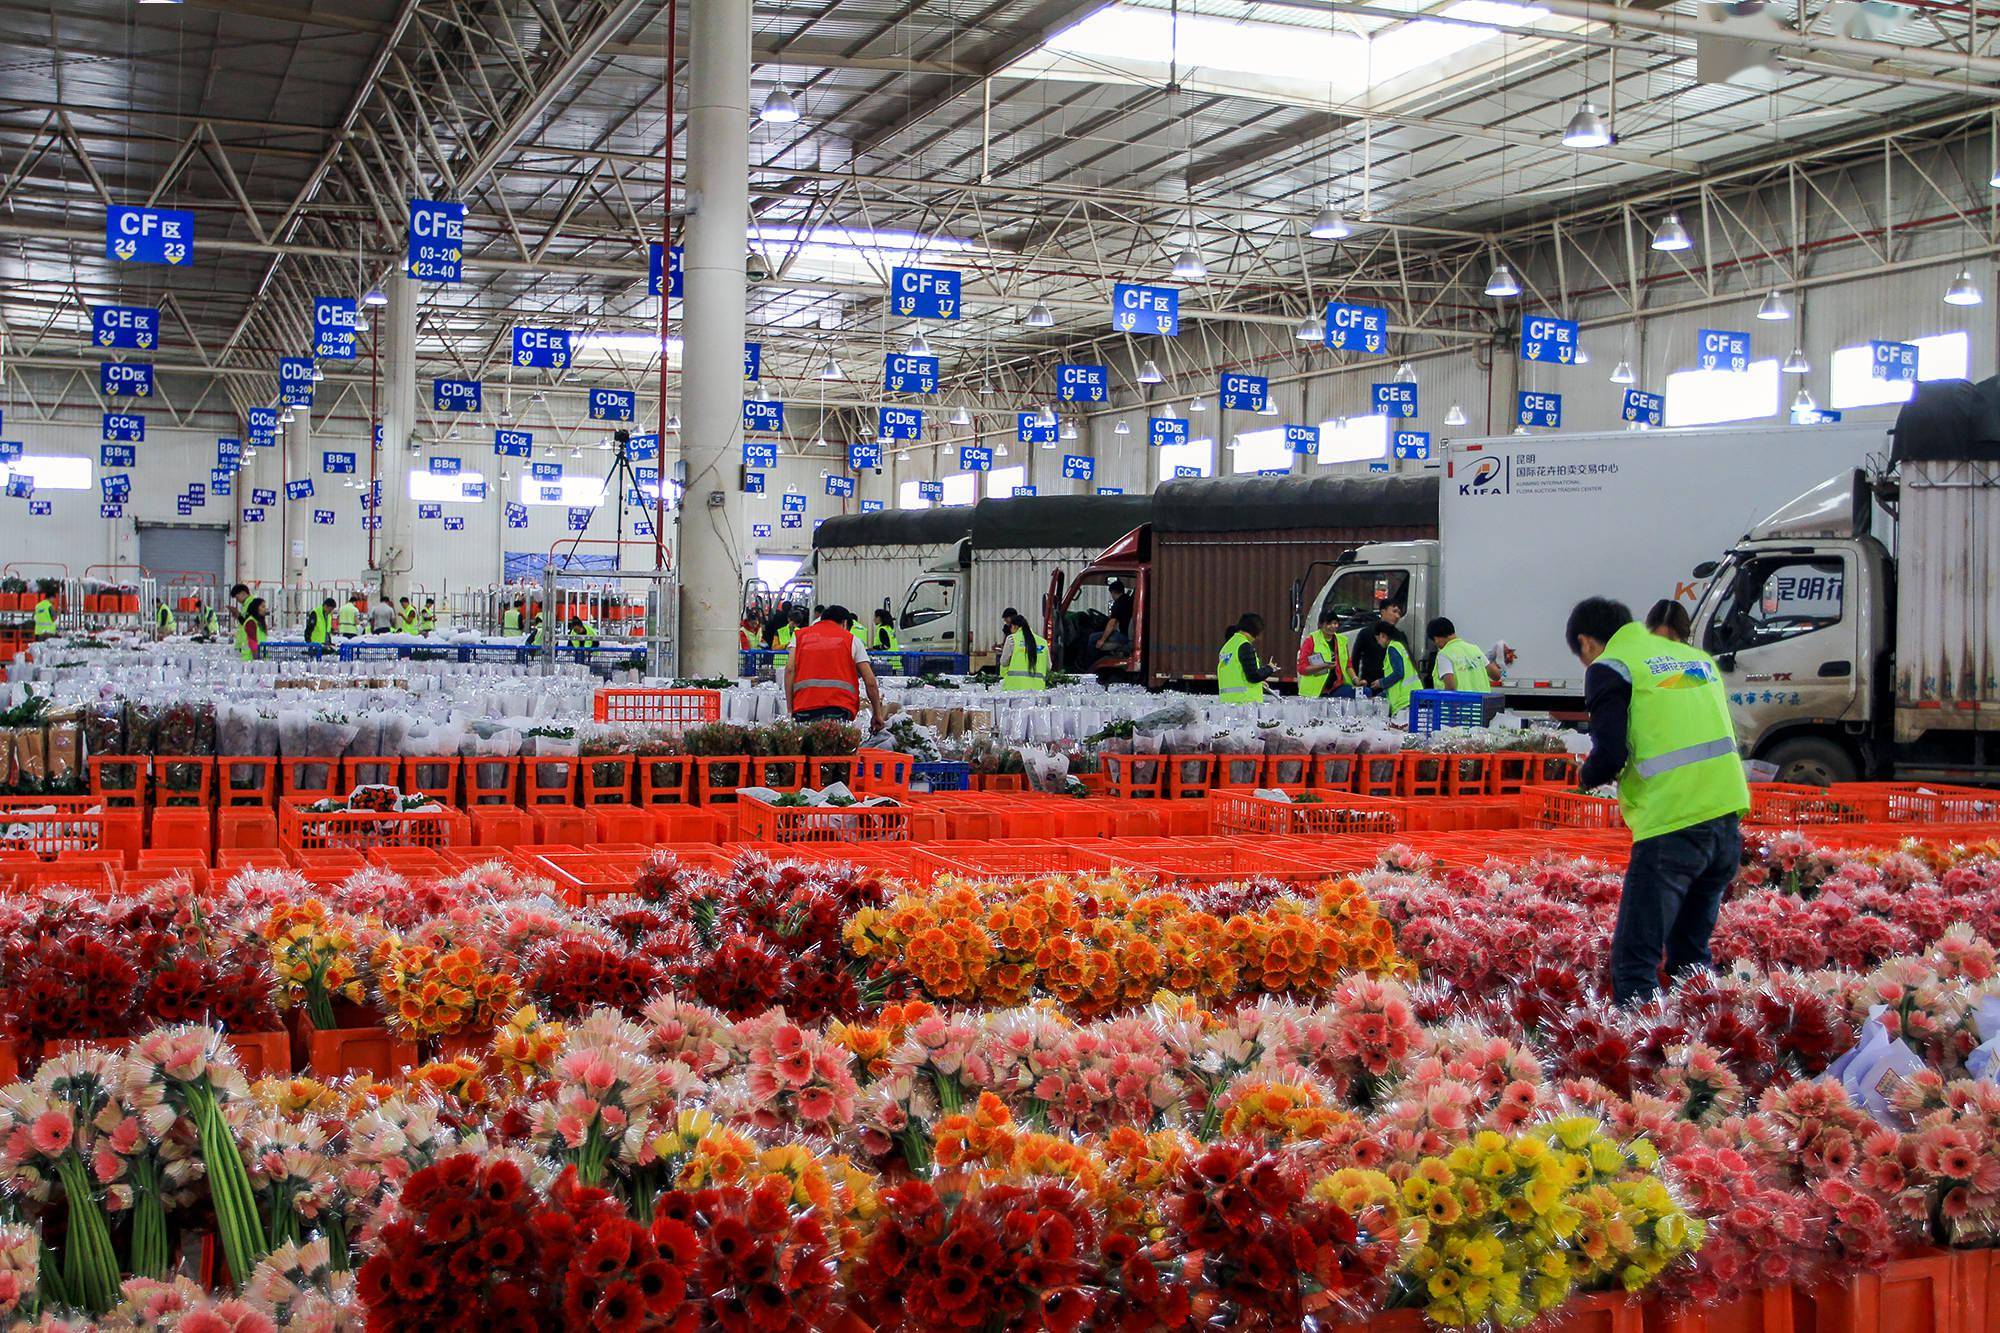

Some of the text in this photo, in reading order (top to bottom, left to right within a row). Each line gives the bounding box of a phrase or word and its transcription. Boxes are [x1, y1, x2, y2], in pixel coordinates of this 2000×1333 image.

[120, 212, 181, 239] CF区
[414, 210, 463, 239] CF区
[114, 238, 186, 257] 24 23
[420, 246, 456, 261] 03-20
[419, 263, 455, 278] 23-40
[902, 272, 951, 296] CF区
[899, 297, 955, 311] 18 17
[1123, 289, 1169, 312] CF区
[103, 310, 149, 329] CE区
[317, 305, 356, 327] CE区
[1120, 312, 1172, 327] 16 15
[1335, 308, 1378, 331] CF区
[99, 330, 153, 344] 24 23
[322, 332, 350, 343] 03-20
[1331, 330, 1380, 346] 14 13
[1530, 321, 1570, 343] CF区
[521, 331, 563, 350] CE区
[1705, 334, 1743, 354] CF区
[322, 345, 351, 356] 23-40
[1527, 342, 1572, 357] 12 11
[1877, 345, 1913, 365] CF区
[518, 350, 566, 363] 20 19
[1703, 355, 1745, 368] 10 09
[282, 362, 313, 380] CD区
[893, 358, 931, 375] CE区
[1873, 365, 1915, 378] 08 07
[108, 366, 146, 382] CD区
[1064, 369, 1100, 384] CE区
[105, 382, 149, 393] 24 23
[891, 376, 934, 388] 16 15
[1227, 378, 1261, 394] CE区
[285, 385, 309, 394] 03-20
[441, 383, 475, 397] CD区
[1062, 386, 1103, 397] 14 13
[1378, 387, 1411, 401] CE区
[286, 395, 310, 403] 23-40
[438, 398, 478, 408] 20 19
[596, 392, 629, 407] CD区
[1225, 394, 1263, 406] 12 11
[1524, 395, 1555, 411] CE区
[1629, 393, 1658, 410] CE区
[594, 407, 631, 418] 18 17
[745, 404, 777, 417] CD区
[1377, 404, 1414, 413] 10 09
[109, 416, 139, 429] CC区
[744, 418, 780, 428] 16 15
[886, 411, 916, 425] CD区
[1522, 411, 1557, 422] 08 07
[1649, 412, 1660, 421] 05
[883, 426, 918, 435] 14 13
[1155, 421, 1183, 434] CD区
[501, 433, 528, 445] CC区
[1022, 430, 1055, 439] 12 11
[1153, 434, 1186, 443] 10 09
[1288, 428, 1315, 441] CD区
[1398, 434, 1425, 446] CD区
[630, 439, 655, 450] CC区
[1306, 442, 1317, 450] 07
[1516, 454, 1536, 464] 昆明
[1516, 464, 1619, 477] 国际花卉拍卖交易中心
[1459, 485, 1501, 496] KIFA
